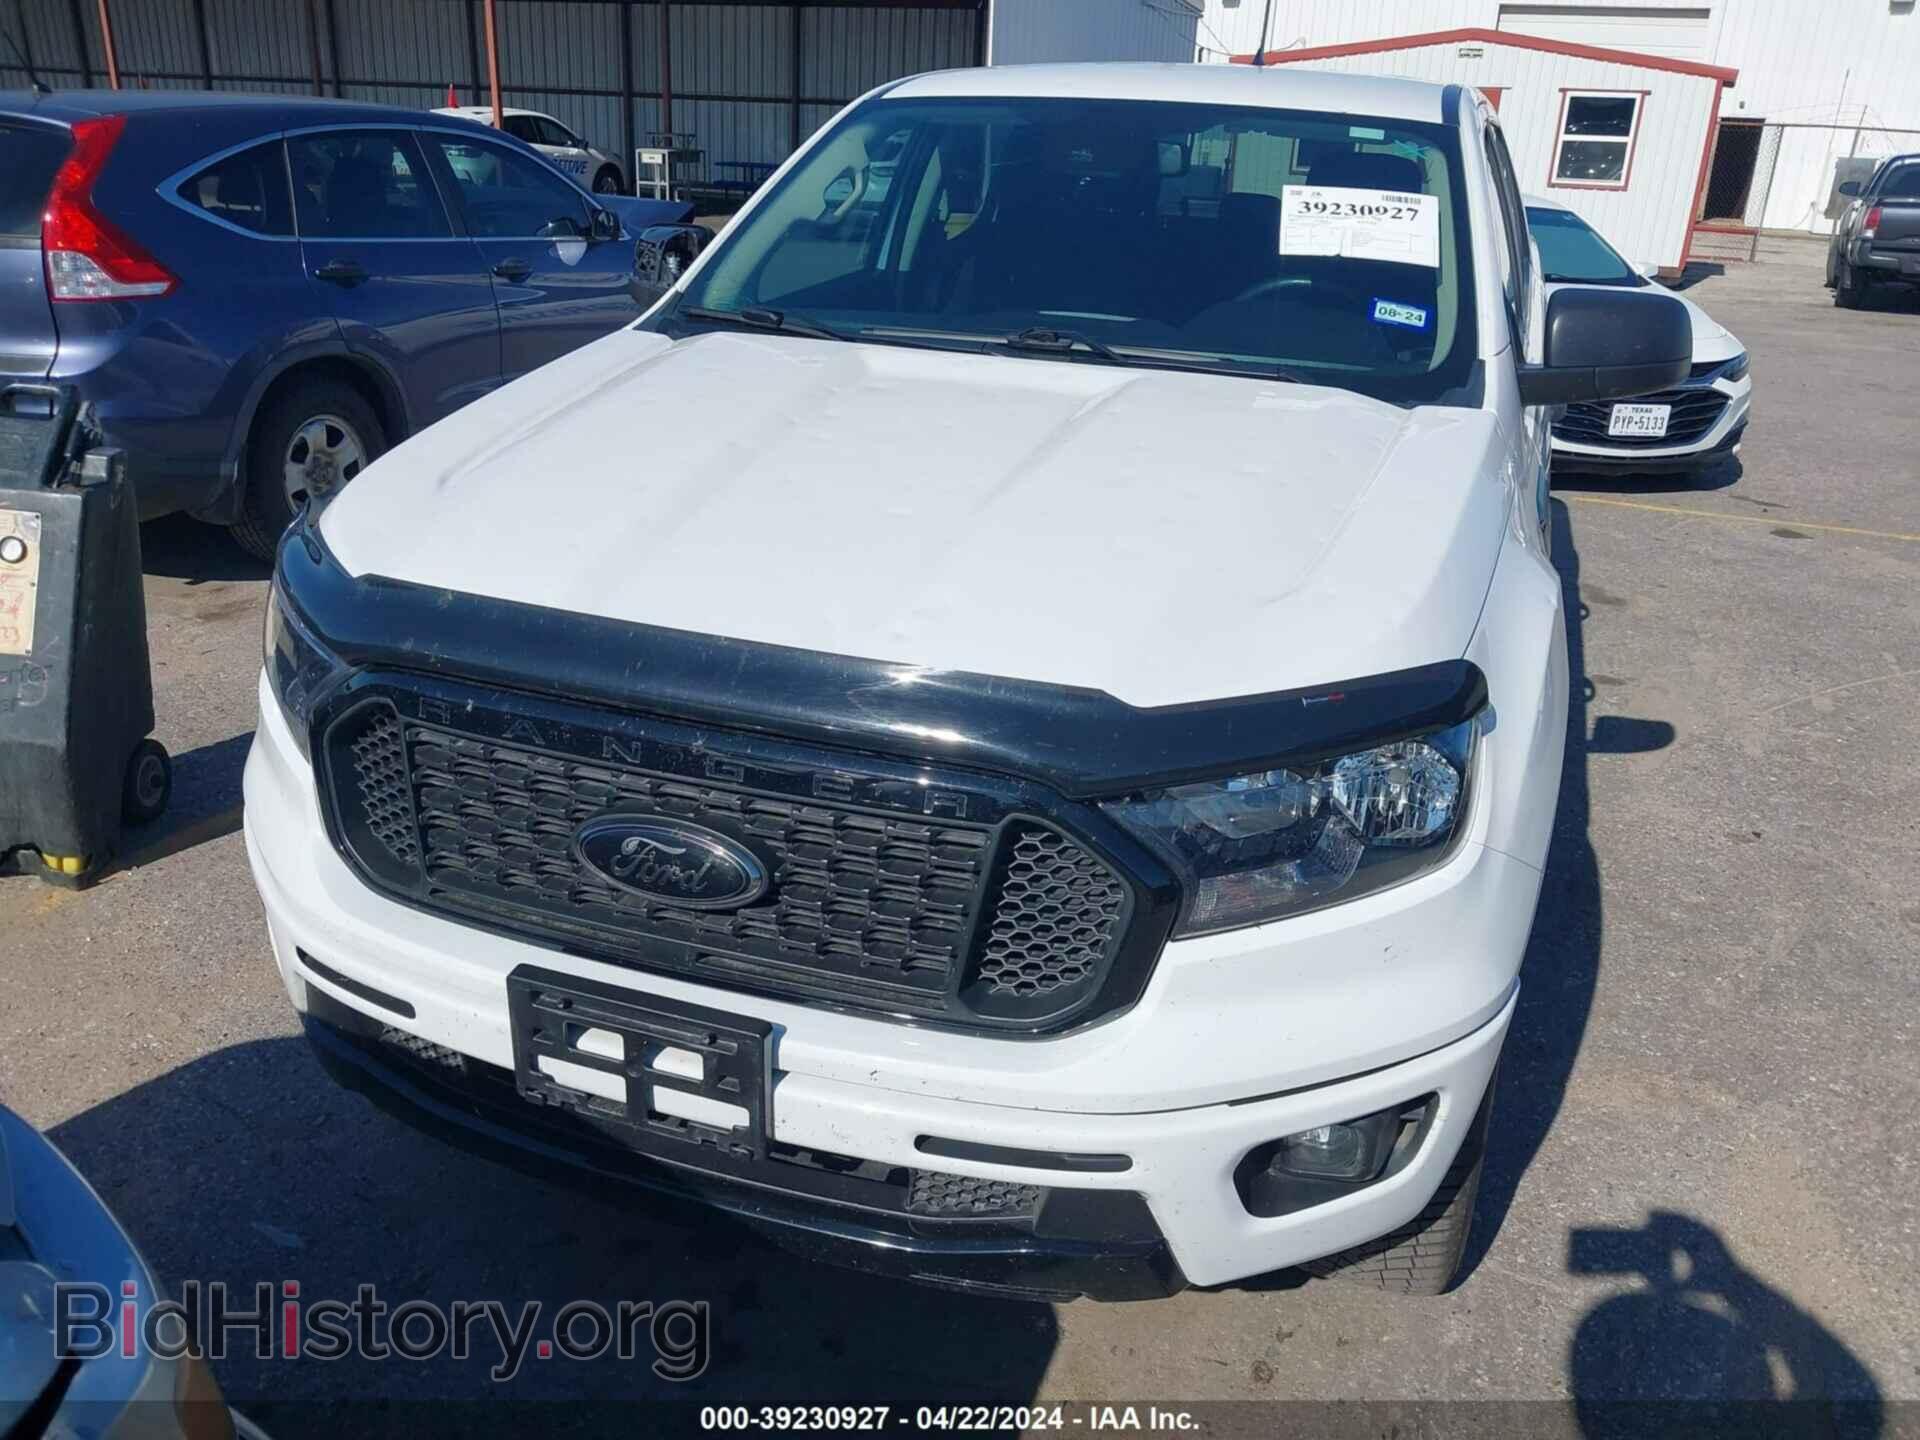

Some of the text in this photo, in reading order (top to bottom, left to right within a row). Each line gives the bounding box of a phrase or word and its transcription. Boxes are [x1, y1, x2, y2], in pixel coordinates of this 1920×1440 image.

[1297, 201, 1419, 221] 39230927
[1378, 306, 1423, 322] 08-24
[417, 696, 968, 818] RANGER
[610, 836, 709, 890] Ford
